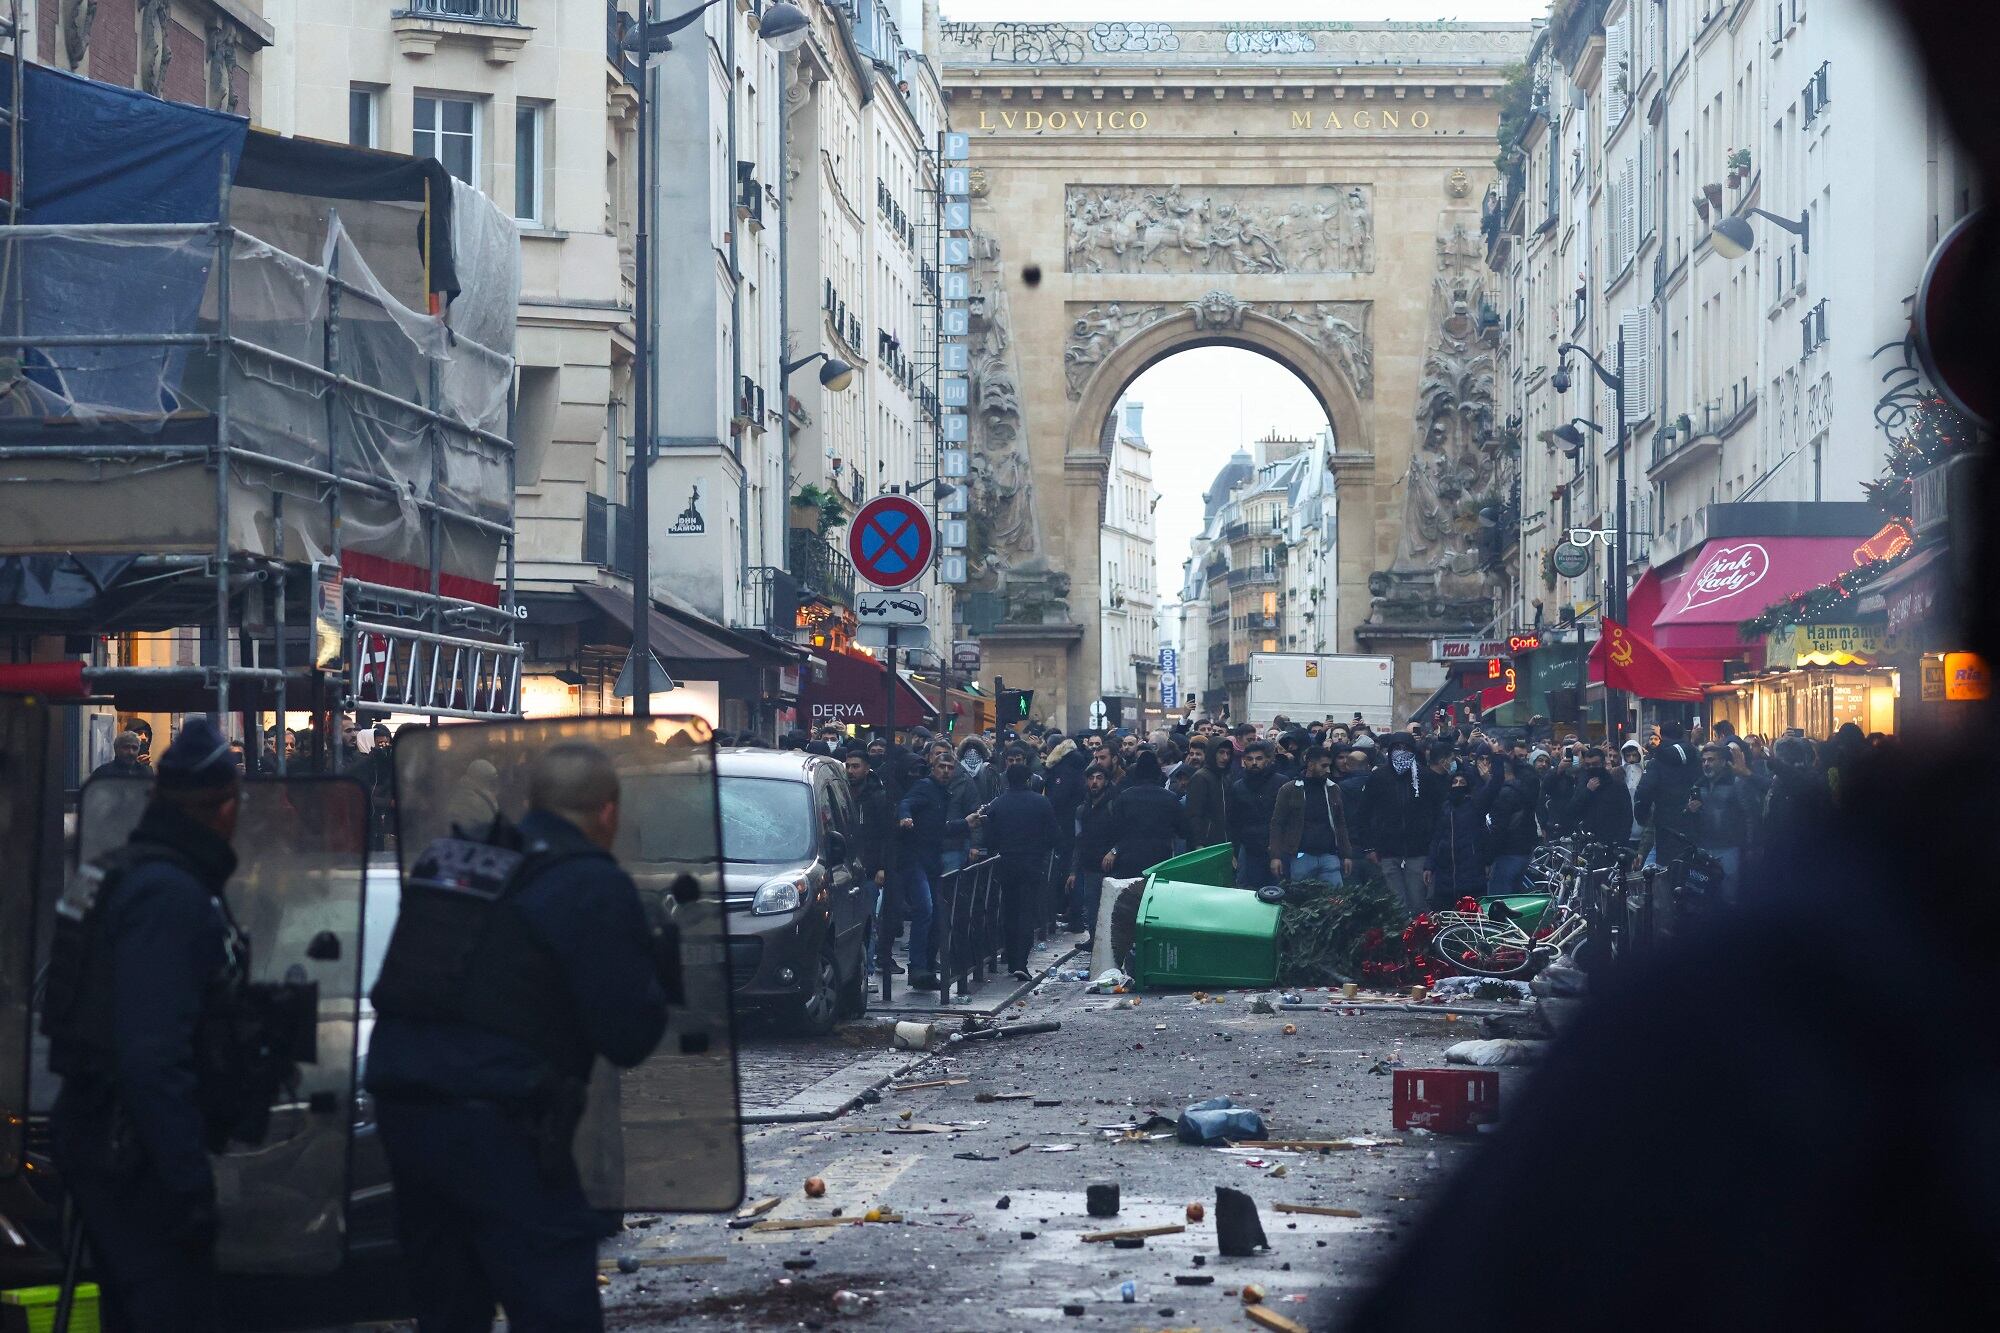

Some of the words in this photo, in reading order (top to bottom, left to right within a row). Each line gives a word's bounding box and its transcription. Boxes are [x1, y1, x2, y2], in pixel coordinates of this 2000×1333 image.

[979, 111, 1148, 129] LVDOVICO
[1291, 110, 1429, 129] MAGNO
[948, 135, 965, 369] PASSAGE
[1704, 551, 1752, 578] Pink
[1697, 570, 1748, 592] Lady
[1841, 640, 1854, 650] 01
[812, 704, 864, 717] DERYA
